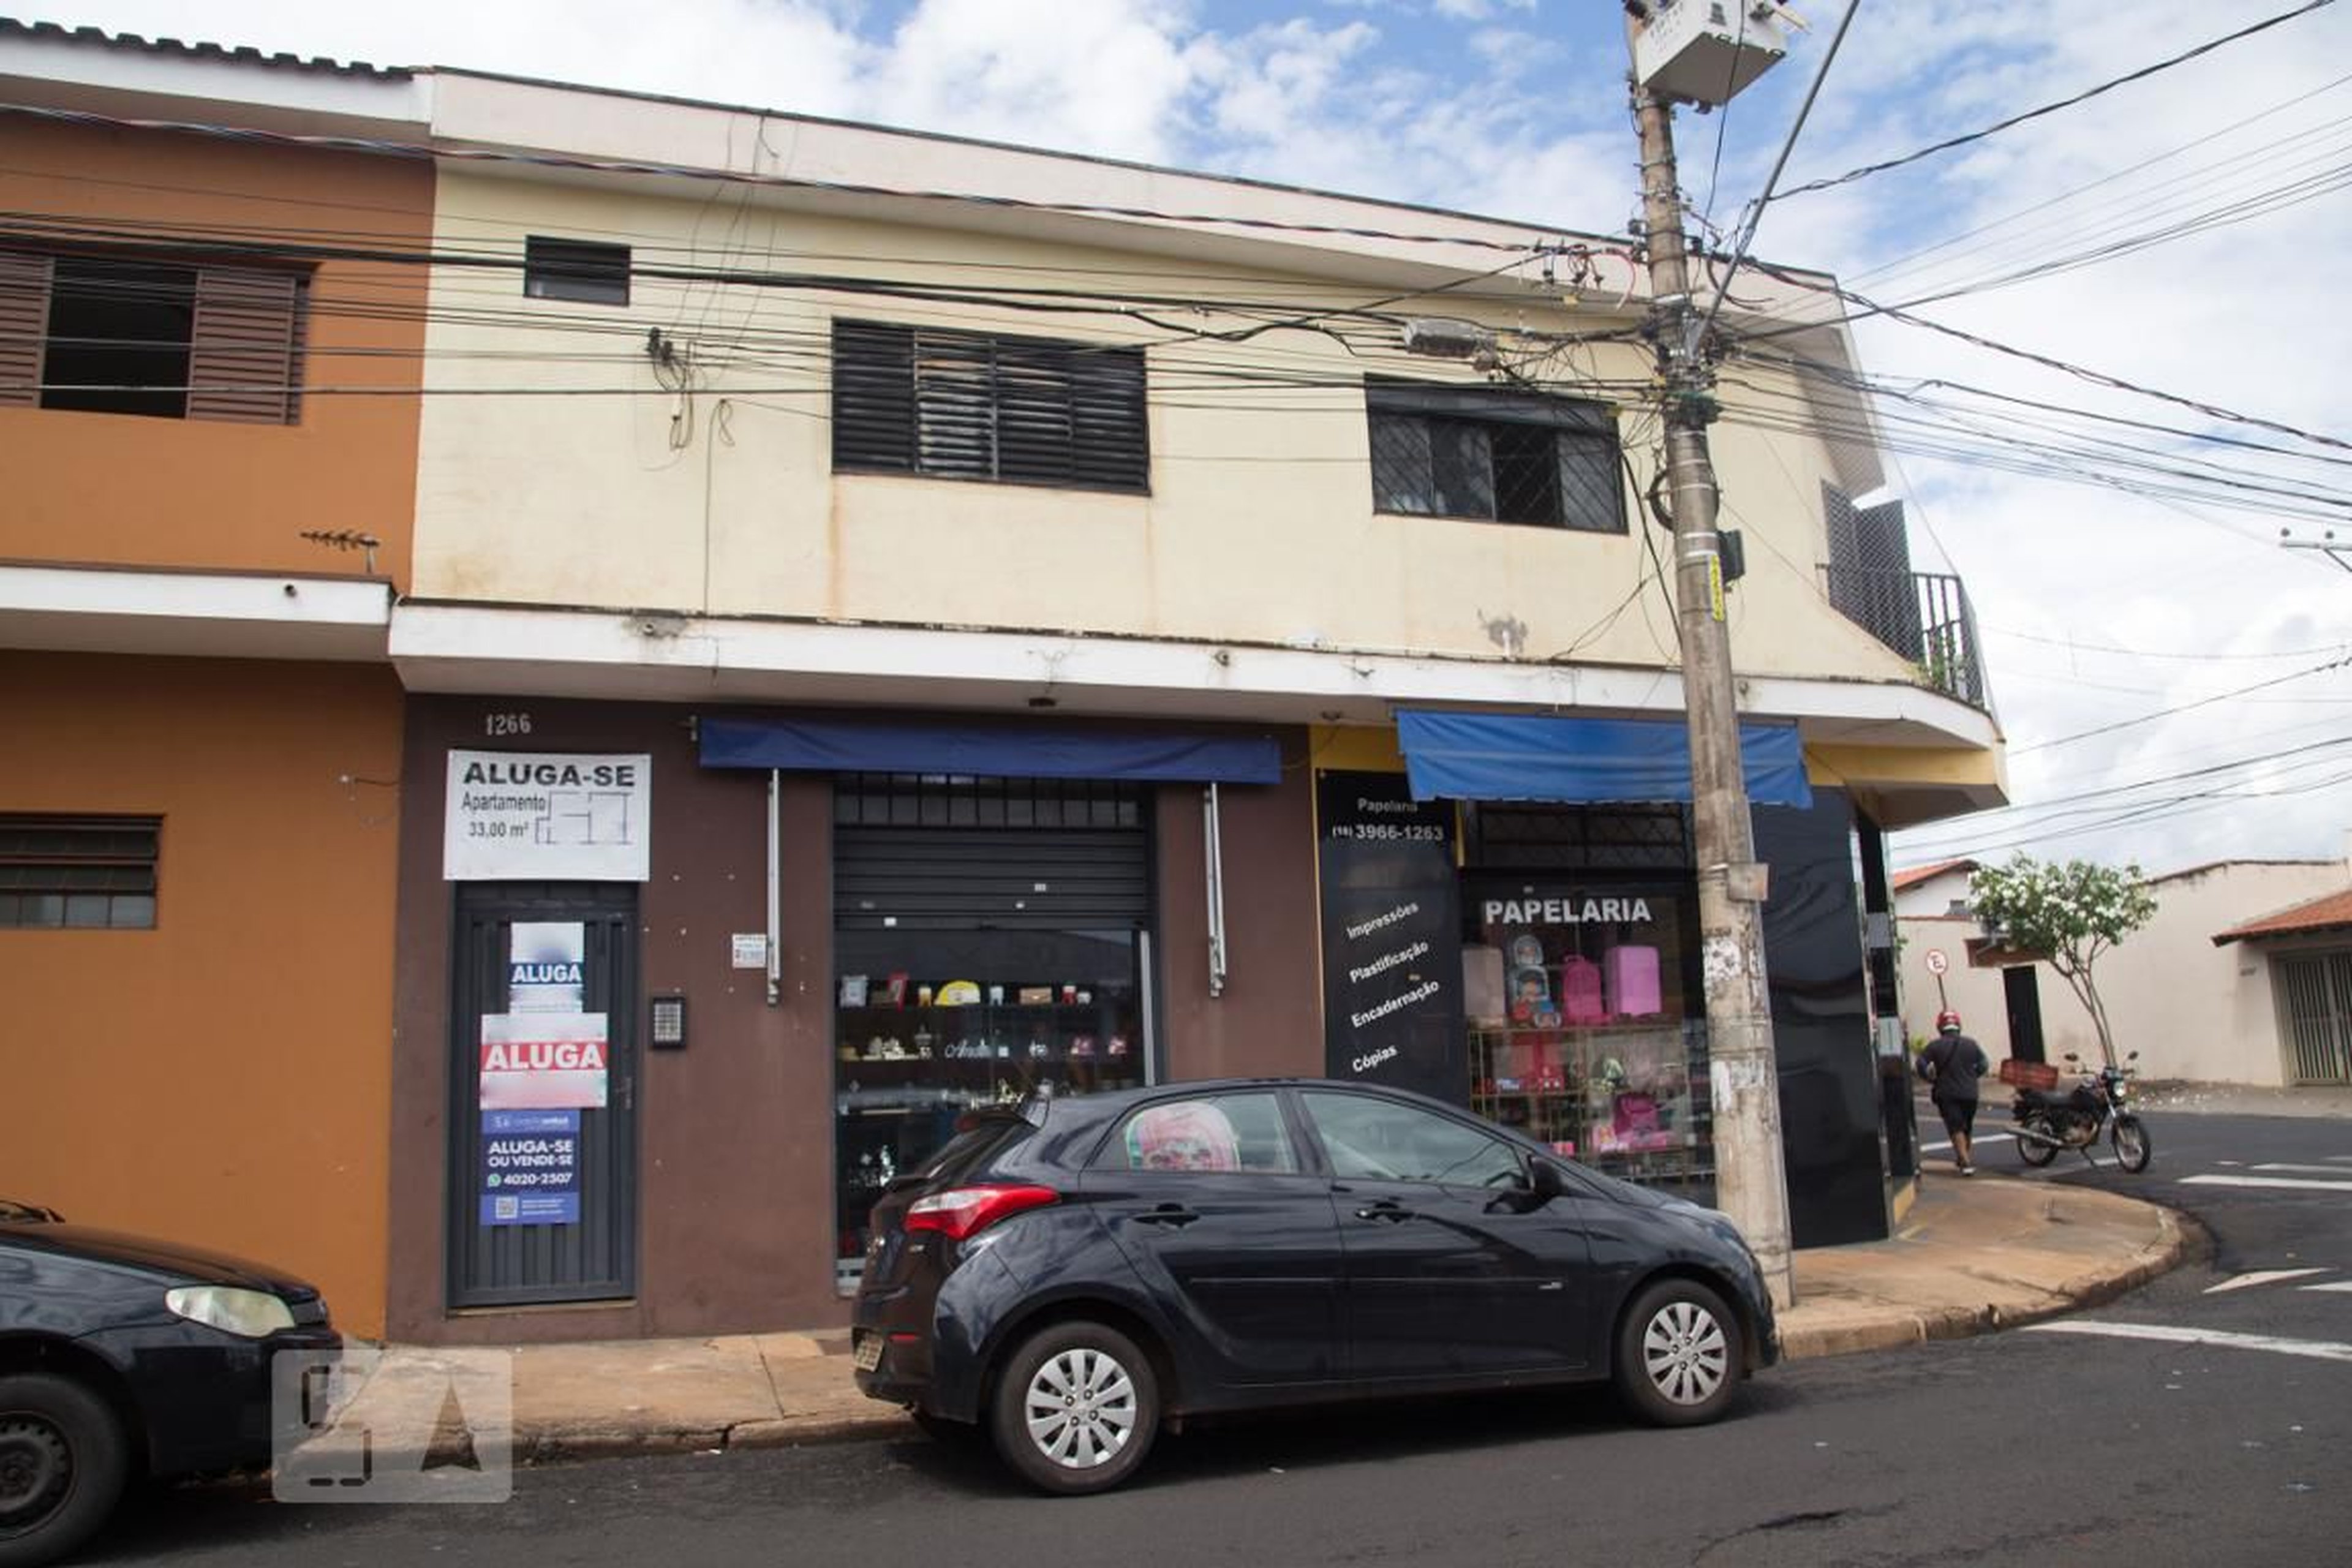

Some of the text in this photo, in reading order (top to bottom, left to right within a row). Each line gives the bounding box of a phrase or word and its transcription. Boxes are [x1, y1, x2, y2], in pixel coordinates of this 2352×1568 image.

[487, 713, 531, 735] 1266
[463, 763, 635, 786] ALUGA-SE
[462, 791, 546, 813] Apartamento
[1357, 797, 1418, 813] Papelaria
[1346, 902, 1419, 938] Impressões
[1485, 898, 1651, 924] PAPELARIA
[511, 964, 582, 983] ALUGA
[1349, 942, 1428, 983] Plastificação
[1351, 981, 1439, 1028] Encadernação
[484, 1044, 604, 1070] ALUGA
[1352, 1045, 1397, 1072] Cópias
[489, 1140, 573, 1154] ALUGA-SE
[489, 1155, 573, 1167] OU VENDE-SE
[503, 1172, 572, 1185] 4020-2507
